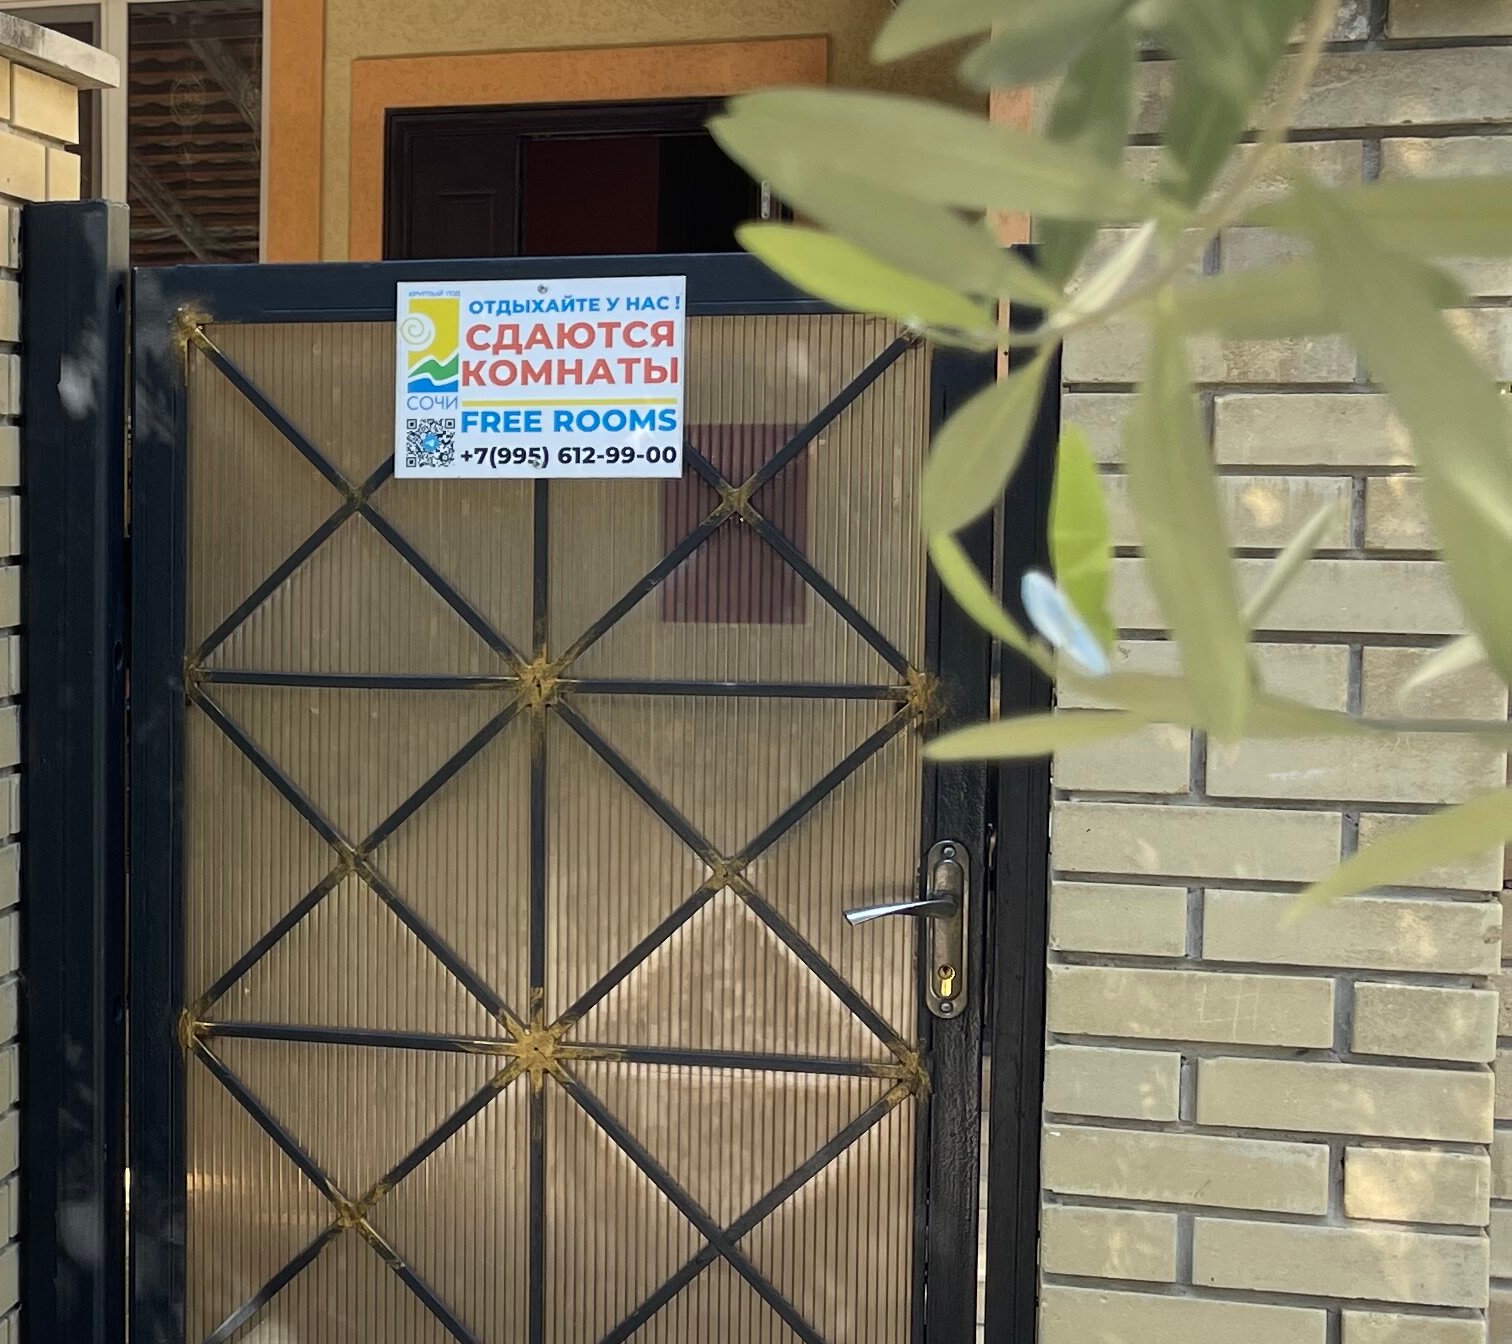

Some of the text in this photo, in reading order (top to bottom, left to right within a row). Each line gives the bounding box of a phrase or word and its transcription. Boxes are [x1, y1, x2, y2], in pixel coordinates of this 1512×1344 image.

[468, 295, 600, 316] ОТДЫХАЙТЕ
[606, 297, 620, 312] У
[626, 296, 669, 311] НАС
[465, 320, 675, 355] СДАЮТСЯ
[461, 357, 679, 387] КОМНАТЫ
[406, 395, 459, 411] СОЧИ
[460, 408, 678, 433] FREE ROOMS
[460, 445, 678, 469] +7(995) 612-99-00
